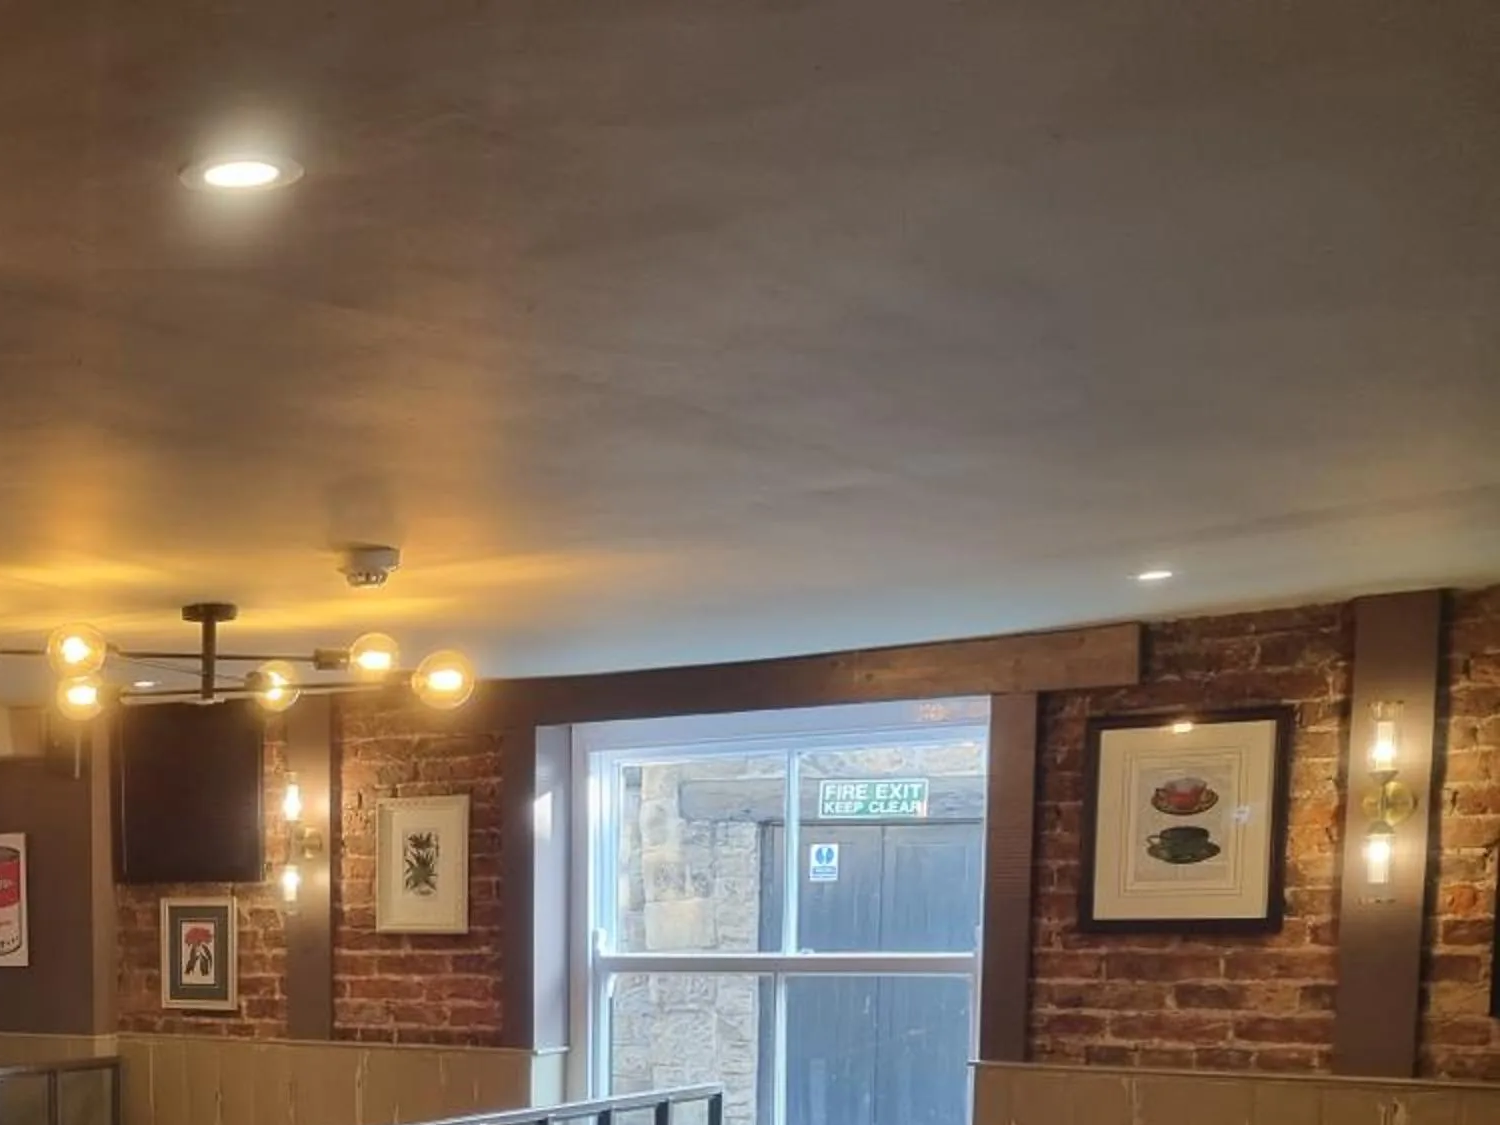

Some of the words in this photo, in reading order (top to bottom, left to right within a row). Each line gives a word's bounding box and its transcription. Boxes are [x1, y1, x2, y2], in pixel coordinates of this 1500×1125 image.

[825, 784, 868, 801] FIRE
[875, 783, 923, 800] EXIT
[824, 801, 864, 813] KEEP
[868, 801, 921, 813] CLEAR
